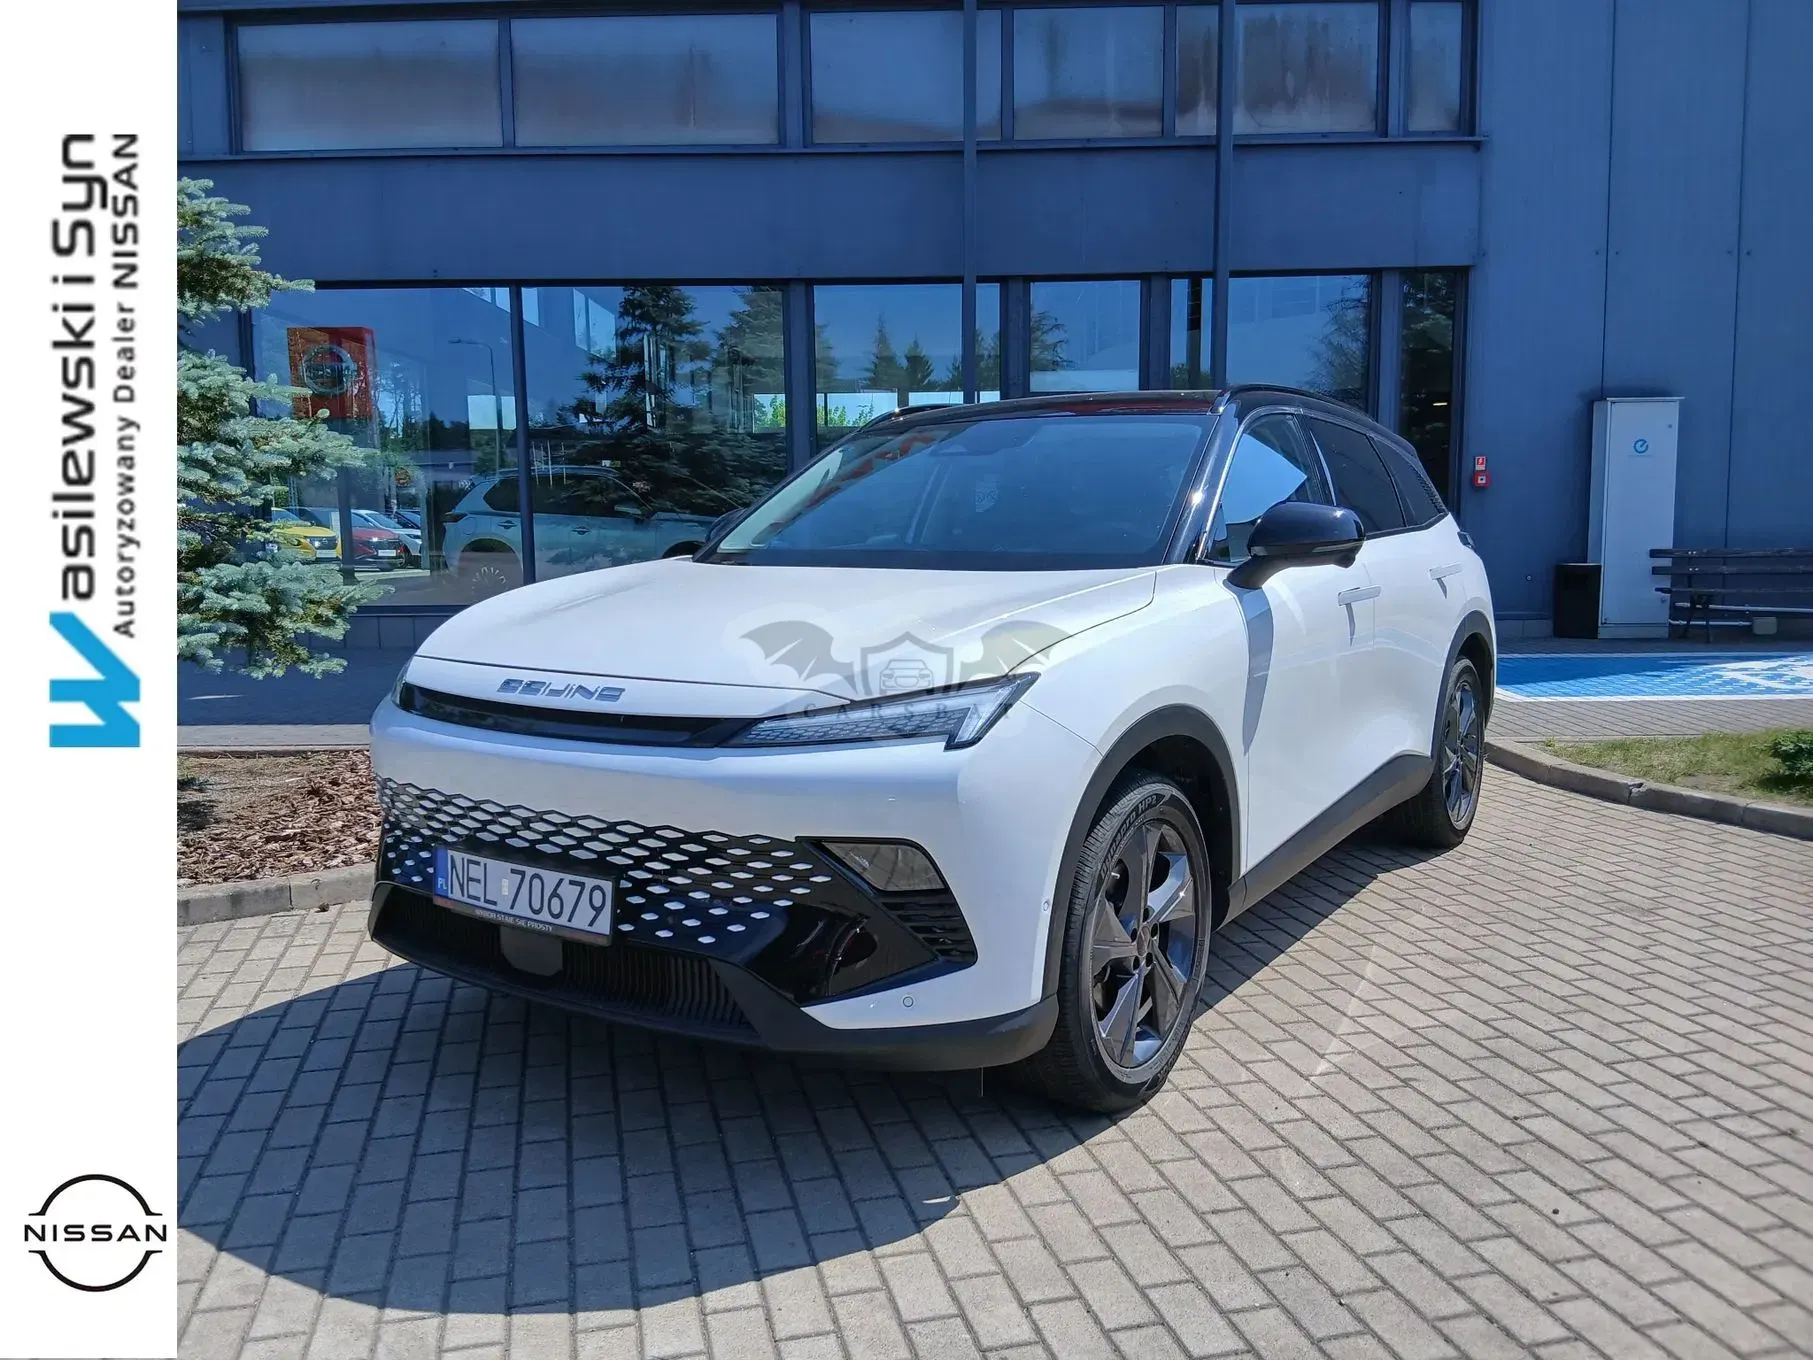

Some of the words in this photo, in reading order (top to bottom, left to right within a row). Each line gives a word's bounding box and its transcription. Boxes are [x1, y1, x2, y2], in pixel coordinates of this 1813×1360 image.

[437, 877, 447, 890] PL
[450, 855, 497, 906] NEL
[510, 868, 607, 927] 70679
